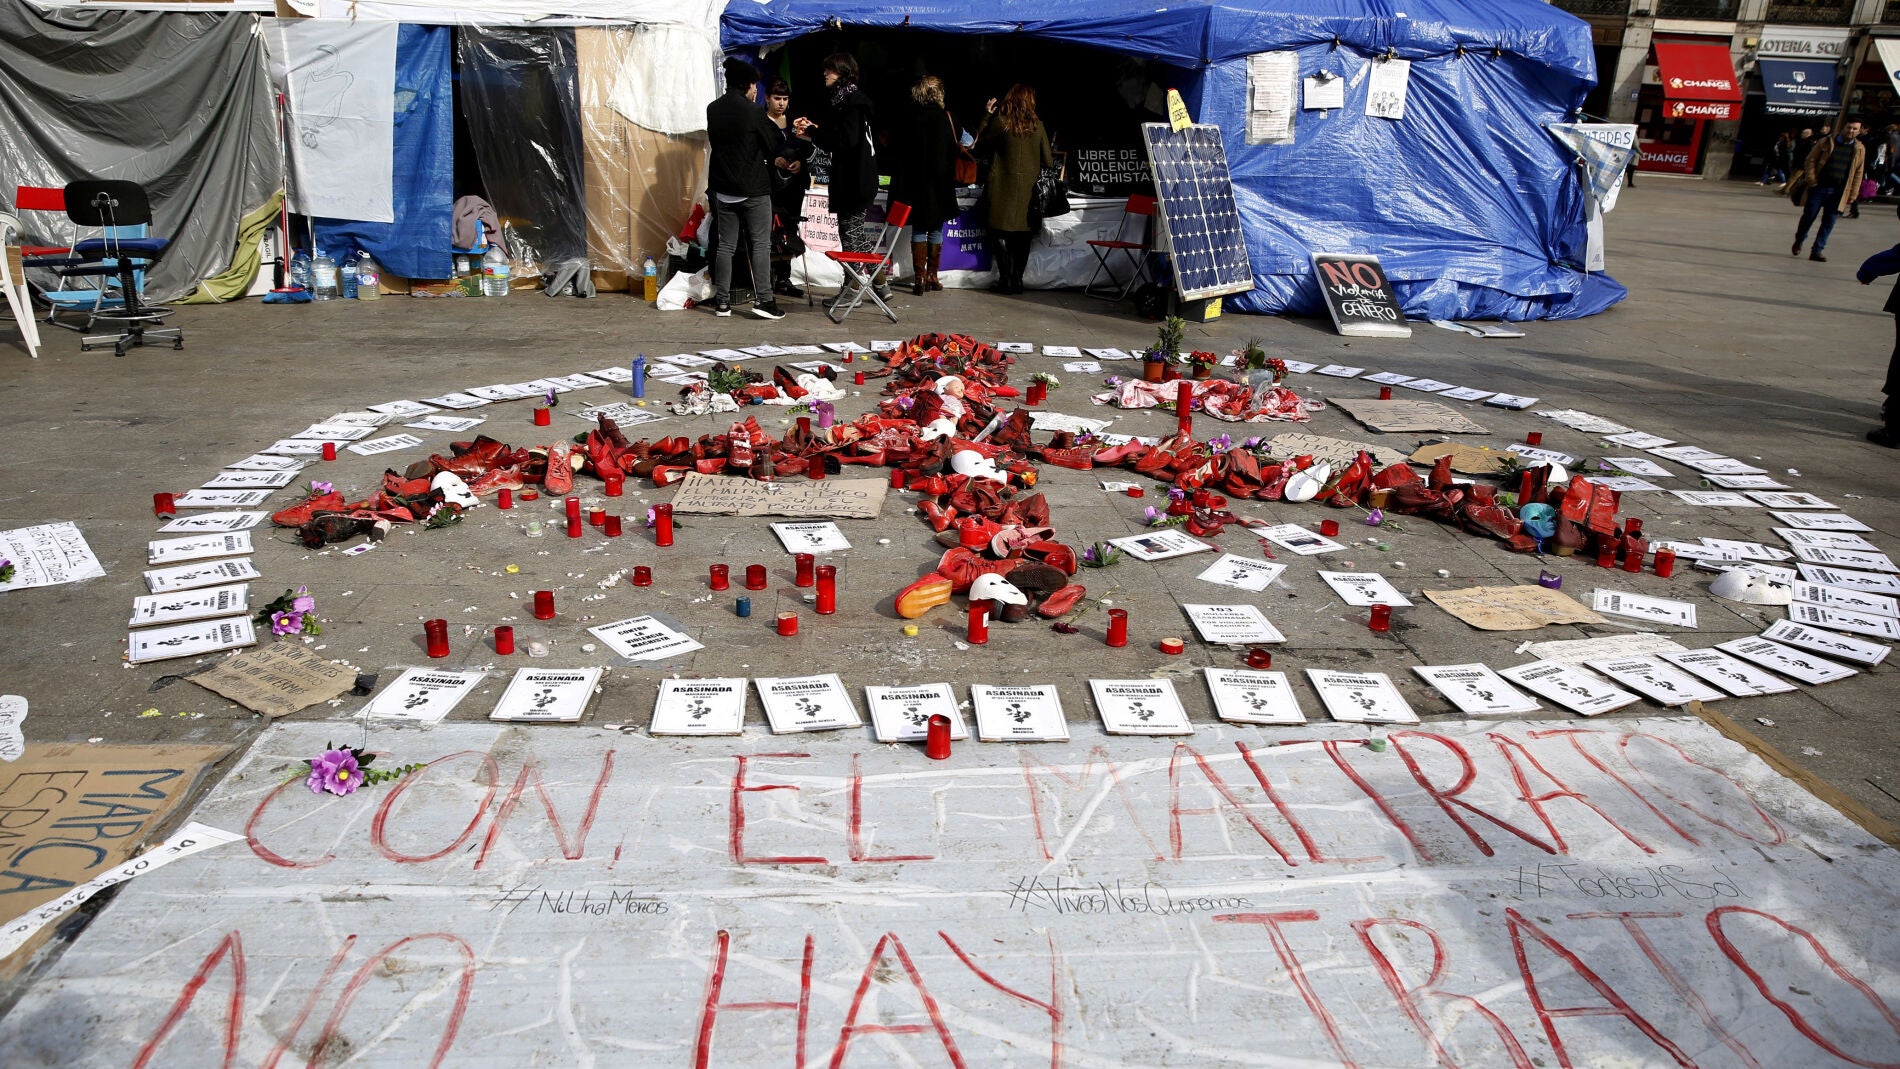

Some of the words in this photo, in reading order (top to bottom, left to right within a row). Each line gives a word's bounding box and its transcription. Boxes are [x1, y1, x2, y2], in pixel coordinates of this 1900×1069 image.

[1816, 41, 1842, 55] SOL
[1683, 80, 1732, 88] CHANGE
[1684, 106, 1730, 115] CHANGE
[1078, 149, 1116, 160] LIBRE
[1120, 149, 1138, 160] DE
[1640, 152, 1689, 164] CHANGE
[808, 196, 817, 207] La
[807, 214, 816, 224] en
[816, 214, 823, 224] el
[960, 242, 983, 252] MATA
[1319, 260, 1382, 290] NO
[710, 487, 793, 497] MALTRATO
[676, 500, 758, 510] MALTRATO
[781, 496, 814, 505] CON
[828, 496, 853, 504] EL
[1228, 558, 1273, 572] ASASINADA
[1332, 576, 1380, 584] ASASINADA
[617, 625, 648, 635] CONTRA
[624, 632, 665, 644] VIOLENCIA
[630, 636, 671, 648] MACHISTA
[1433, 671, 1486, 679] ASASINADA
[409, 676, 466, 686] ASASINADA
[1220, 677, 1277, 685] ASASINADA
[1324, 677, 1379, 685] ASASINADA
[771, 682, 830, 692] ASASINADA
[881, 692, 941, 701] ASASINADA
[730, 752, 934, 866] EL
[1014, 730, 1790, 868] MALTRATO
[0, 768, 186, 896] MARCA
[166, 838, 197, 857] DE
[132, 928, 476, 1069] NO
[688, 928, 1064, 1069] HAY
[1210, 904, 1900, 1069] TRATO
